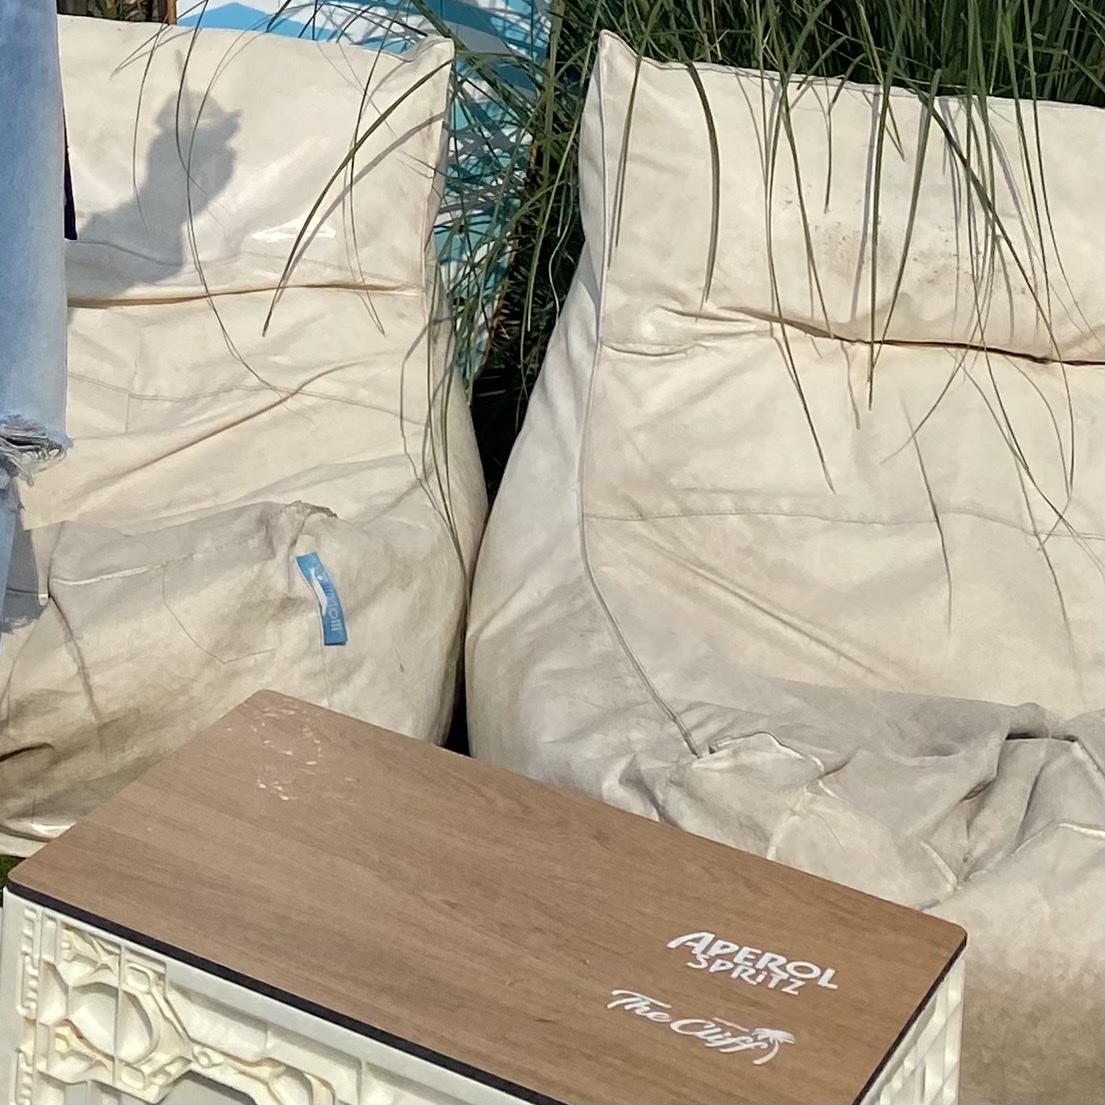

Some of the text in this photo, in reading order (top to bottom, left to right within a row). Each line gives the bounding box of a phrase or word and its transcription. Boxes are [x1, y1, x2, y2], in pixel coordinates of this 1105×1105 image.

[666, 931, 838, 989] APEROL
[607, 989, 672, 1023] The
[670, 1018, 769, 1053] Cliff
